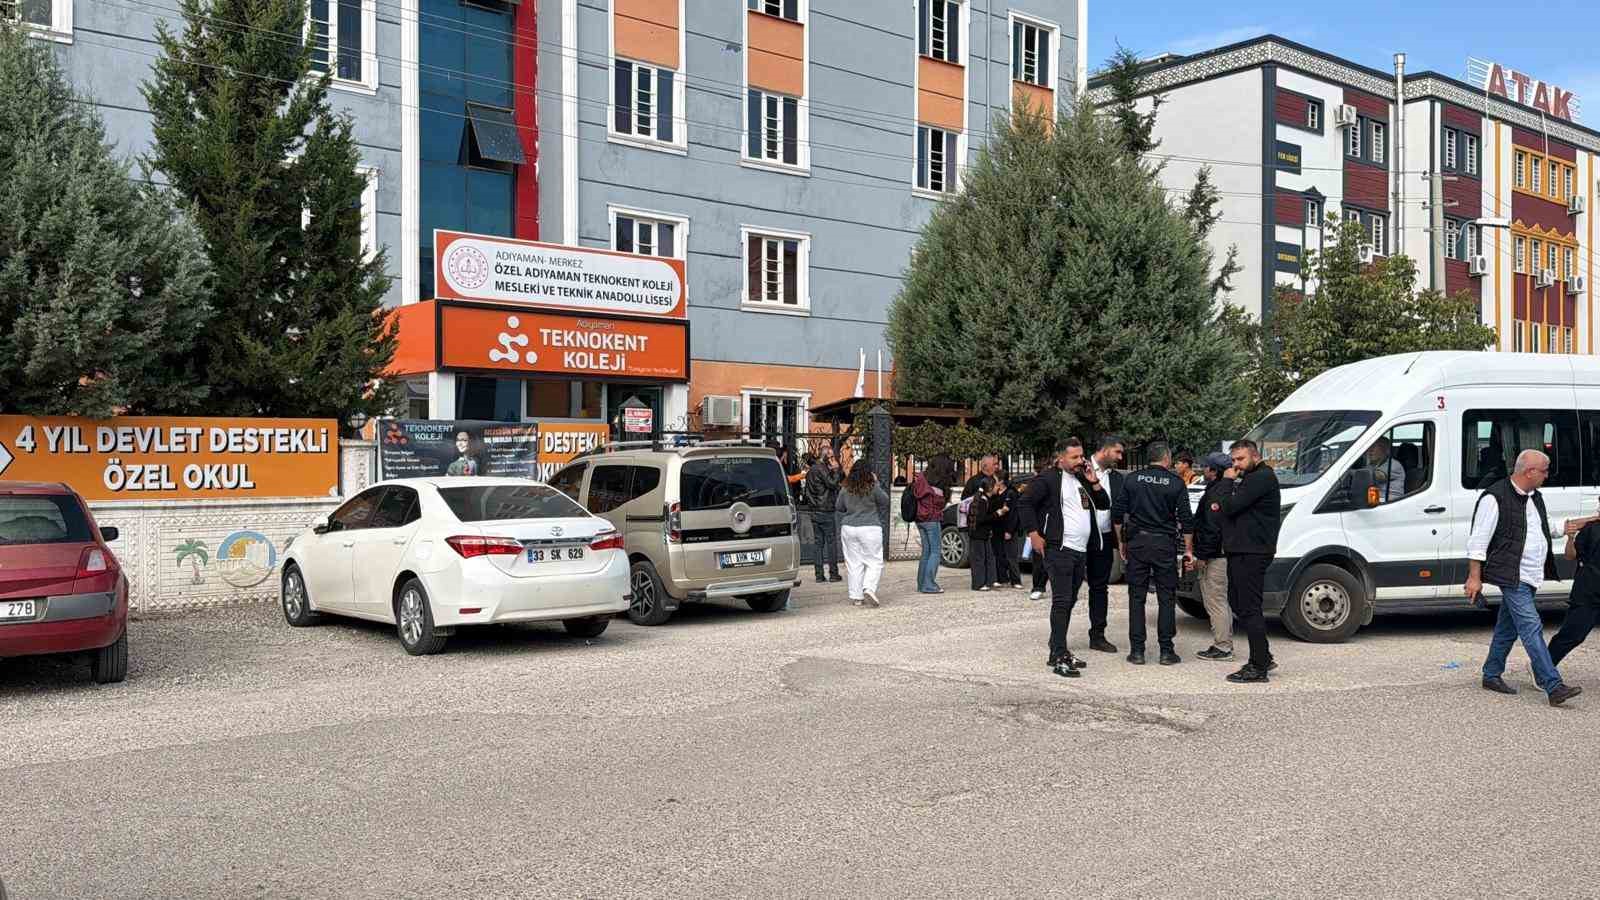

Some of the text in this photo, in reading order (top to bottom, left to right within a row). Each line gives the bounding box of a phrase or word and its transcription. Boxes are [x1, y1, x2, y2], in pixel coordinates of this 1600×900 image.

[1487, 63, 1574, 121] ATAK
[549, 257, 584, 269] MERKEZ
[494, 262, 523, 277] ÖZEL
[524, 267, 581, 282] ADIYAMAN
[583, 273, 641, 289] TEKNOKENT
[494, 280, 673, 307] MESLEKİ VE TEKNİK ANADOLU LİSESİ
[539, 328, 648, 352] TEKNOKENT
[1437, 396, 1445, 409] 3
[15, 425, 36, 453] 4
[43, 425, 90, 453] YIL
[97, 426, 204, 453] DEVLET
[404, 423, 455, 433] TEKNOKENT
[103, 457, 256, 492] ÖZEL OKUL
[533, 548, 584, 561] 33 SK 629
[8, 602, 33, 616] 278
